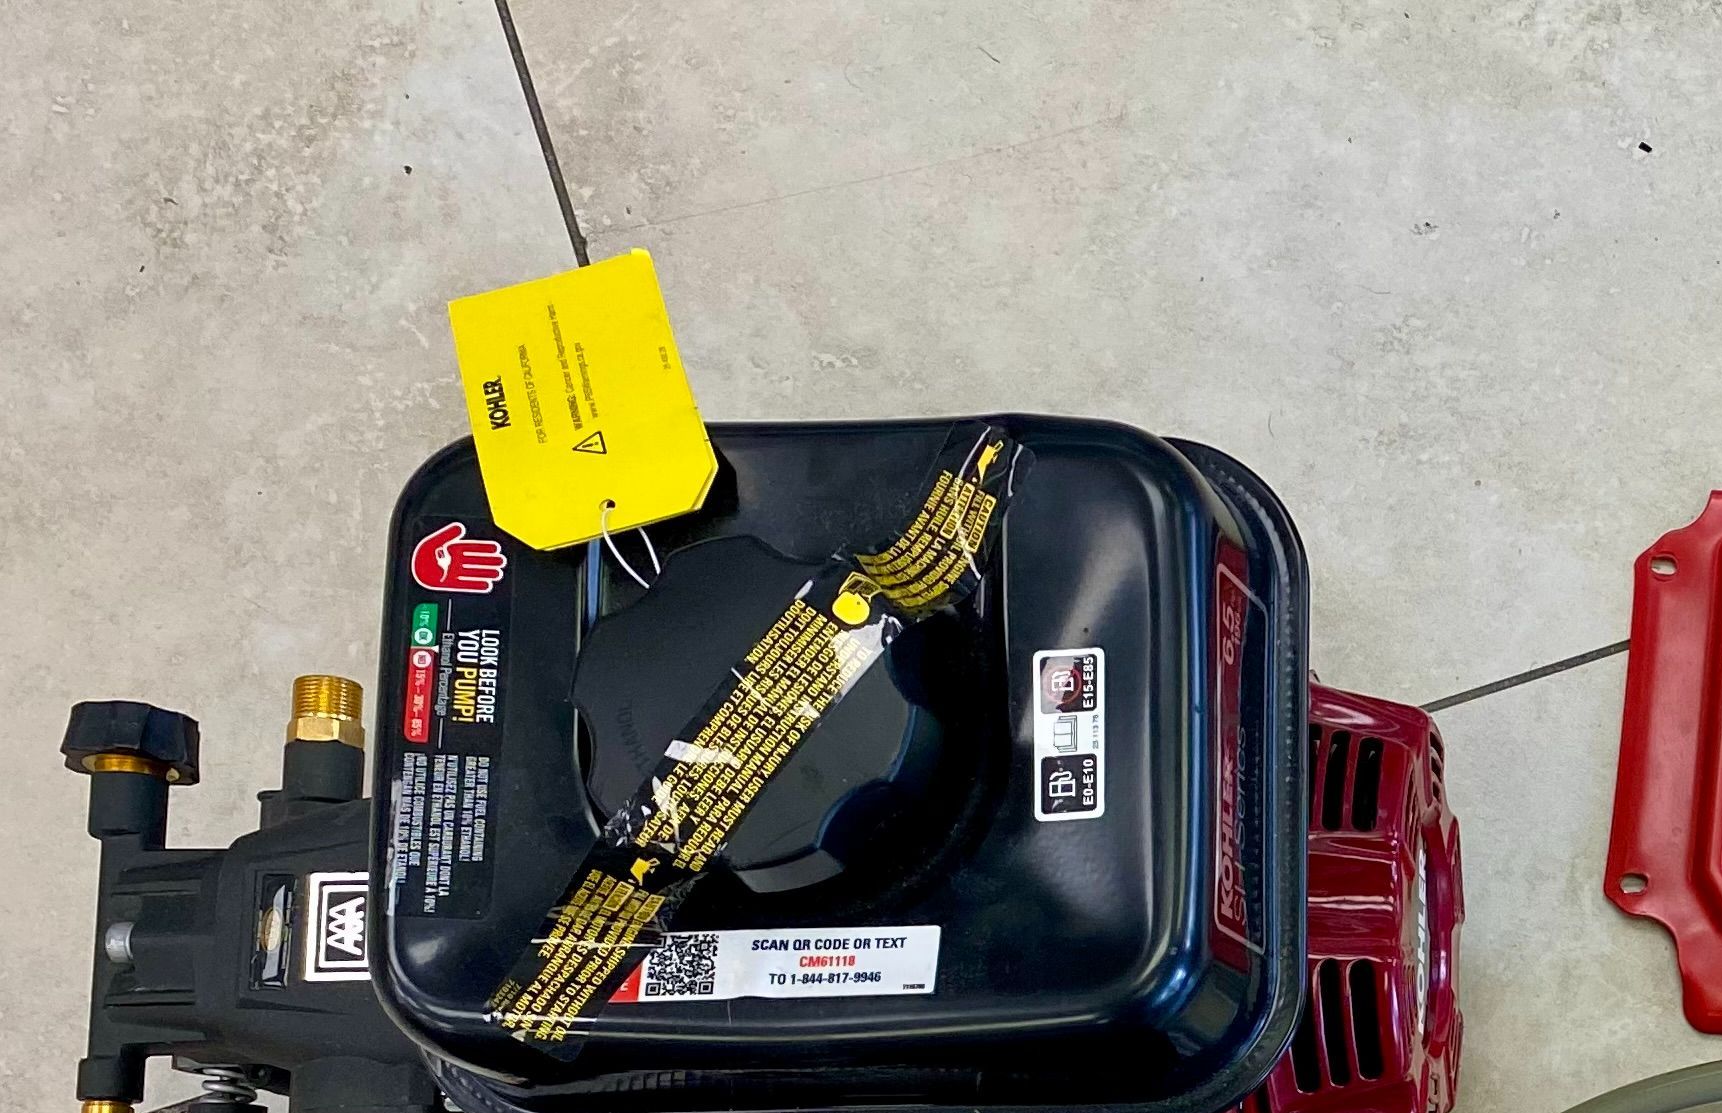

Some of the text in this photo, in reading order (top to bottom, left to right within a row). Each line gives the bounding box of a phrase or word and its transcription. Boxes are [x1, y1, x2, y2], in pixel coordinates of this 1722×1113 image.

[482, 378, 511, 430] KOHLER
[904, 469, 952, 540] FOURNIE AVANT
[968, 497, 994, 549] CAUTION
[434, 632, 454, 716] Ethanol Percentage
[452, 628, 479, 722] YOU PUMP!
[475, 629, 499, 723] LOOK BEFORE
[726, 612, 828, 730] MINIMISER LES DE
[742, 620, 838, 729] ENTENDER EL DE
[1080, 656, 1095, 707] E15-E85
[464, 756, 476, 787] GREATER
[693, 660, 823, 816] DE EL DEBE LEER
[462, 789, 474, 808] THAN
[471, 756, 488, 861] DO NOT USE FUEL CONTAINING
[688, 690, 835, 872] THE OF USER MUST READ AND
[704, 795, 731, 823] PARA
[1081, 758, 1095, 805] E0-E10
[1233, 725, 1248, 848] Series
[1218, 753, 1239, 918] KOHLER
[751, 937, 907, 951] SCAN QR CODE OR TEXT
[799, 954, 855, 968] CM61118
[1409, 848, 1433, 1034] KOHLER
[564, 981, 581, 997] TO
[769, 970, 881, 985] TO 1-844-817-9946
